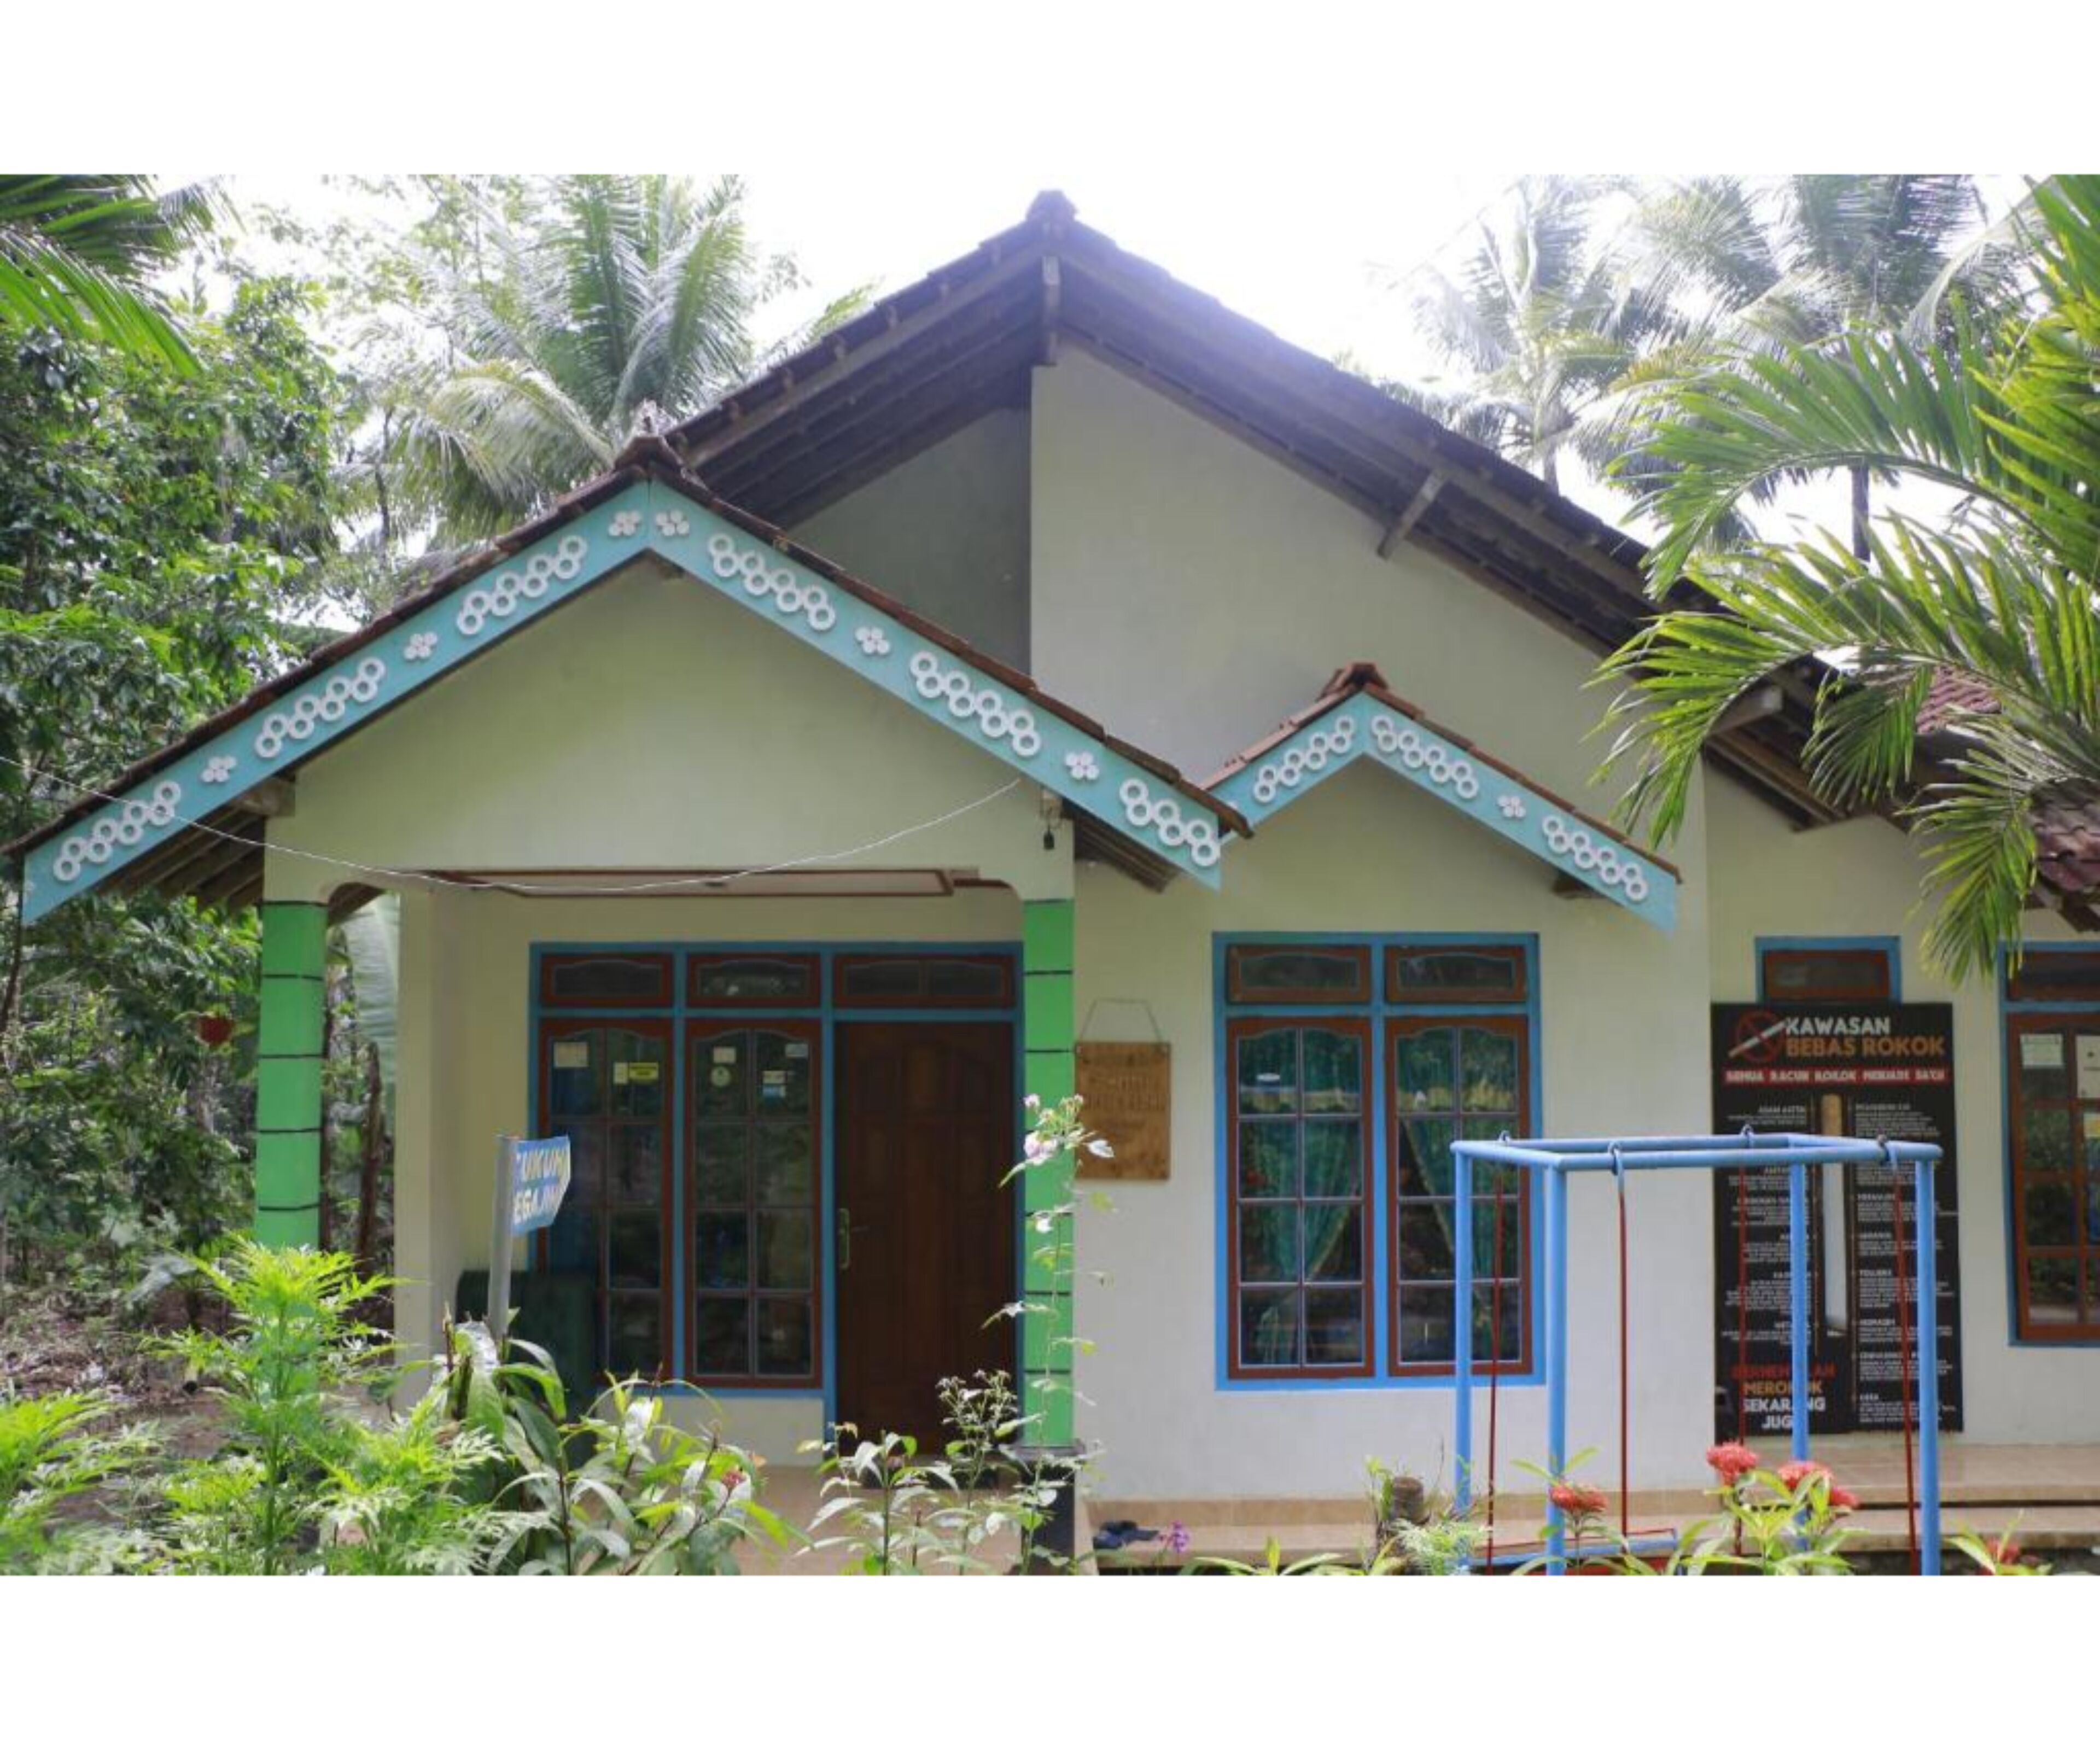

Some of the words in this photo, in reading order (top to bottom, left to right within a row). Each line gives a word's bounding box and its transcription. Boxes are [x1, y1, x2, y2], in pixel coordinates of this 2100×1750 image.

[1786, 1017, 1891, 1035] KAWASAN
[1786, 1038, 1856, 1058] BEBAS
[1862, 1037, 1945, 1057] ROKOK
[1743, 1380, 1823, 1395] MEROK
[1743, 1397, 1825, 1412] SEKARNG
